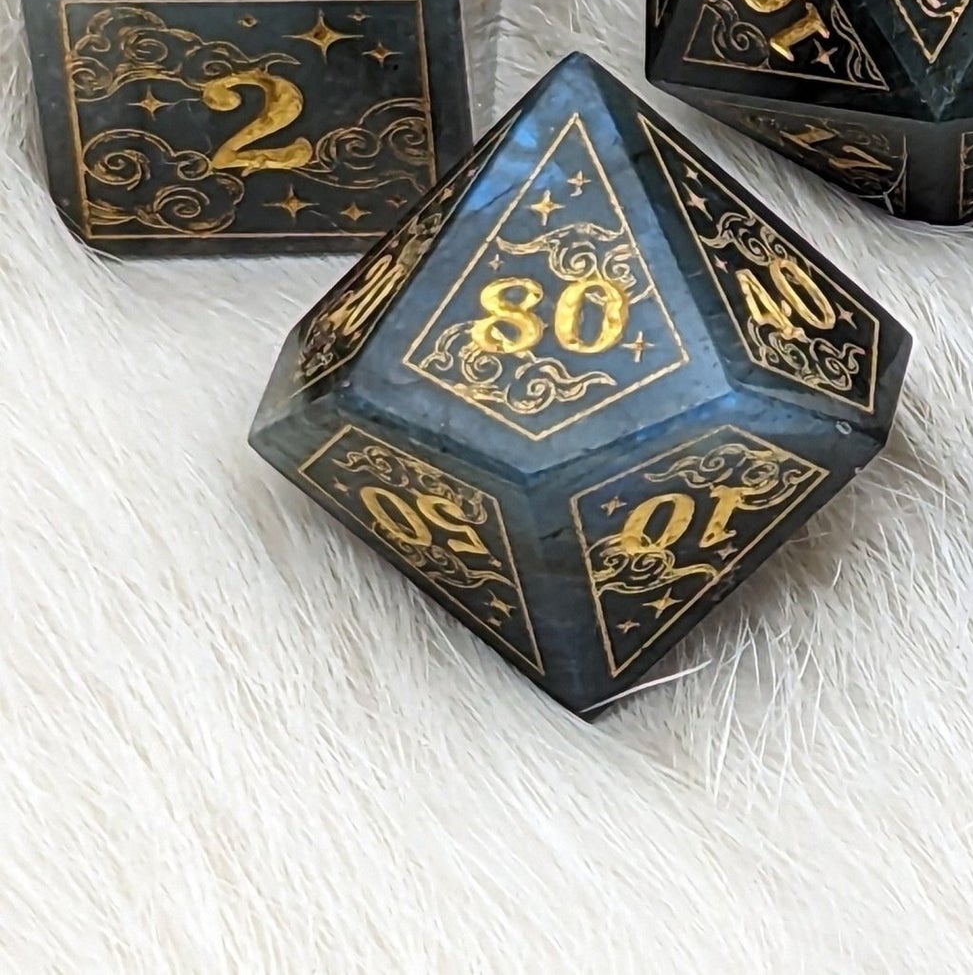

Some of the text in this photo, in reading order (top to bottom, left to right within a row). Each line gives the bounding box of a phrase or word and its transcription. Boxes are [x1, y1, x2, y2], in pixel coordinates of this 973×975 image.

[203, 72, 313, 170] 2
[470, 276, 632, 355] 80
[735, 258, 836, 344] 40
[360, 486, 490, 555] 50
[619, 484, 746, 556] 10
